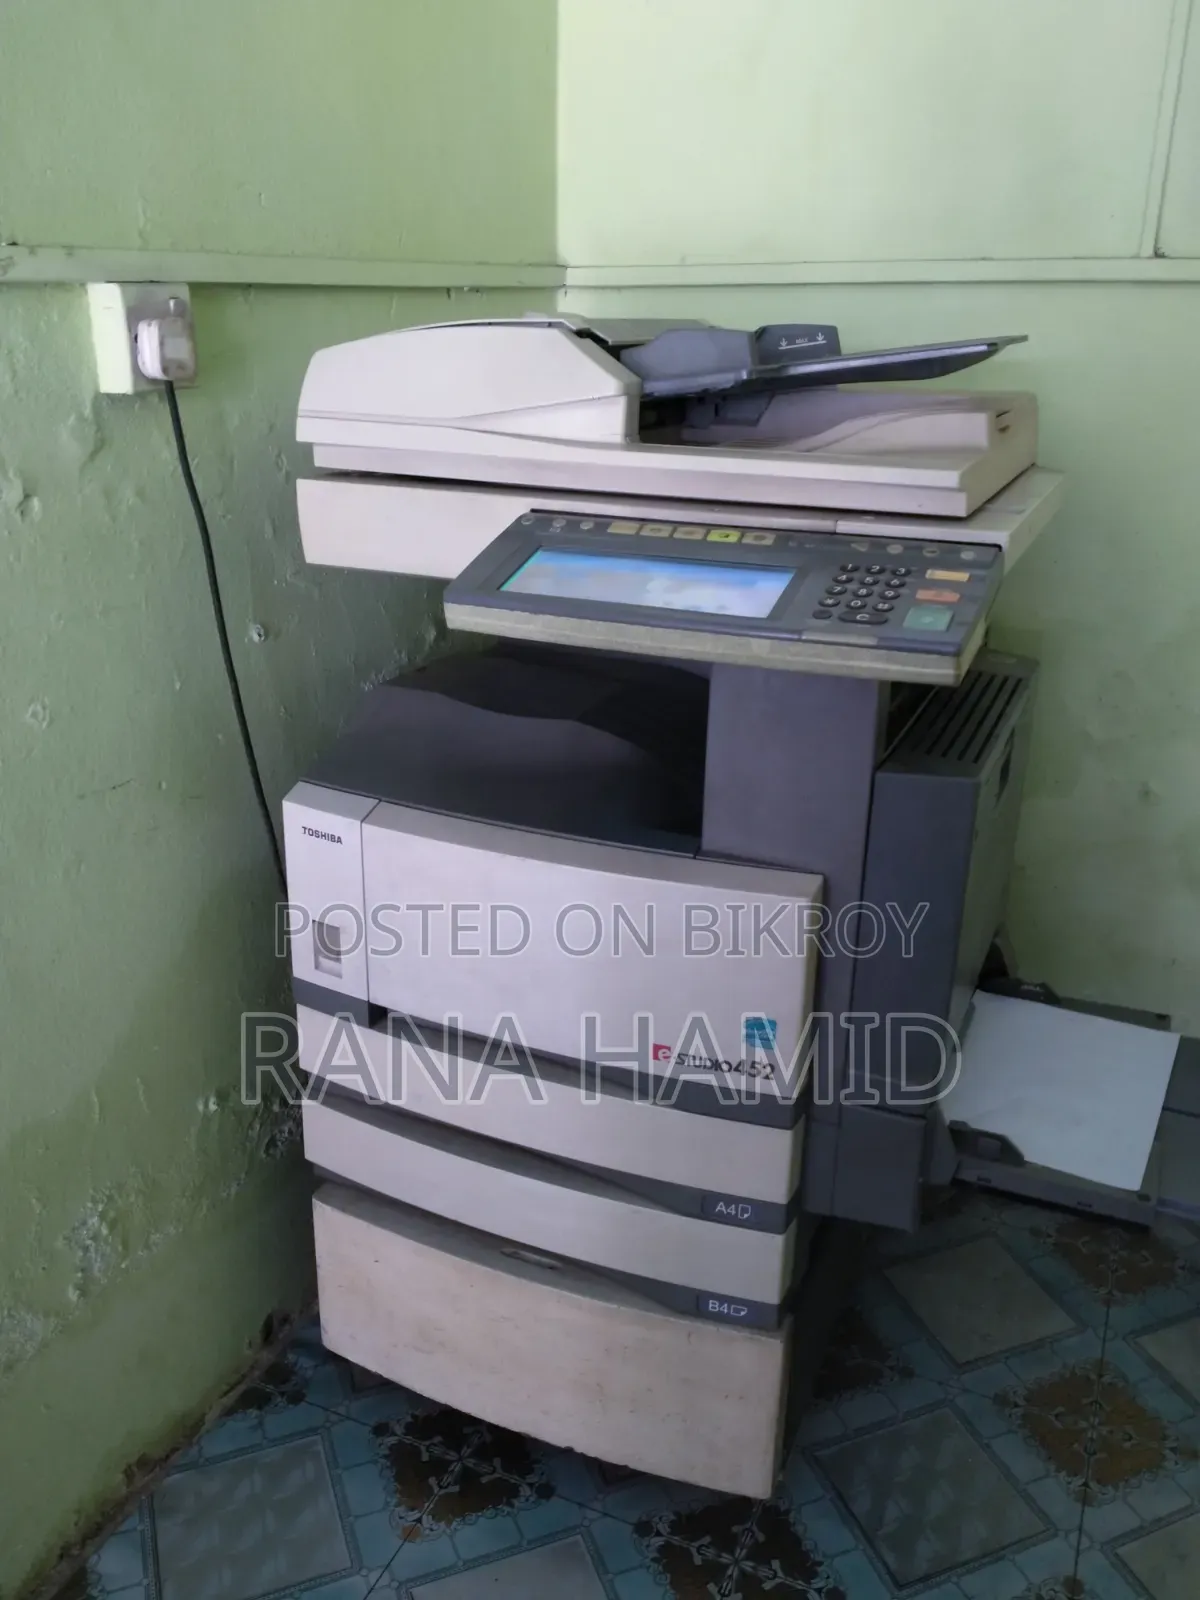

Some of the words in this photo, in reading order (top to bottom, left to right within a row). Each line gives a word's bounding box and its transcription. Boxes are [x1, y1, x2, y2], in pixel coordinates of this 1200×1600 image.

[896, 567, 906, 575] 3
[864, 576, 874, 584] 5
[890, 578, 900, 586] 6
[858, 588, 867, 596] 8
[856, 613, 870, 621] C
[301, 825, 343, 845] TOSHIBA
[715, 1201, 736, 1216] A4
[708, 1299, 728, 1314] B4
